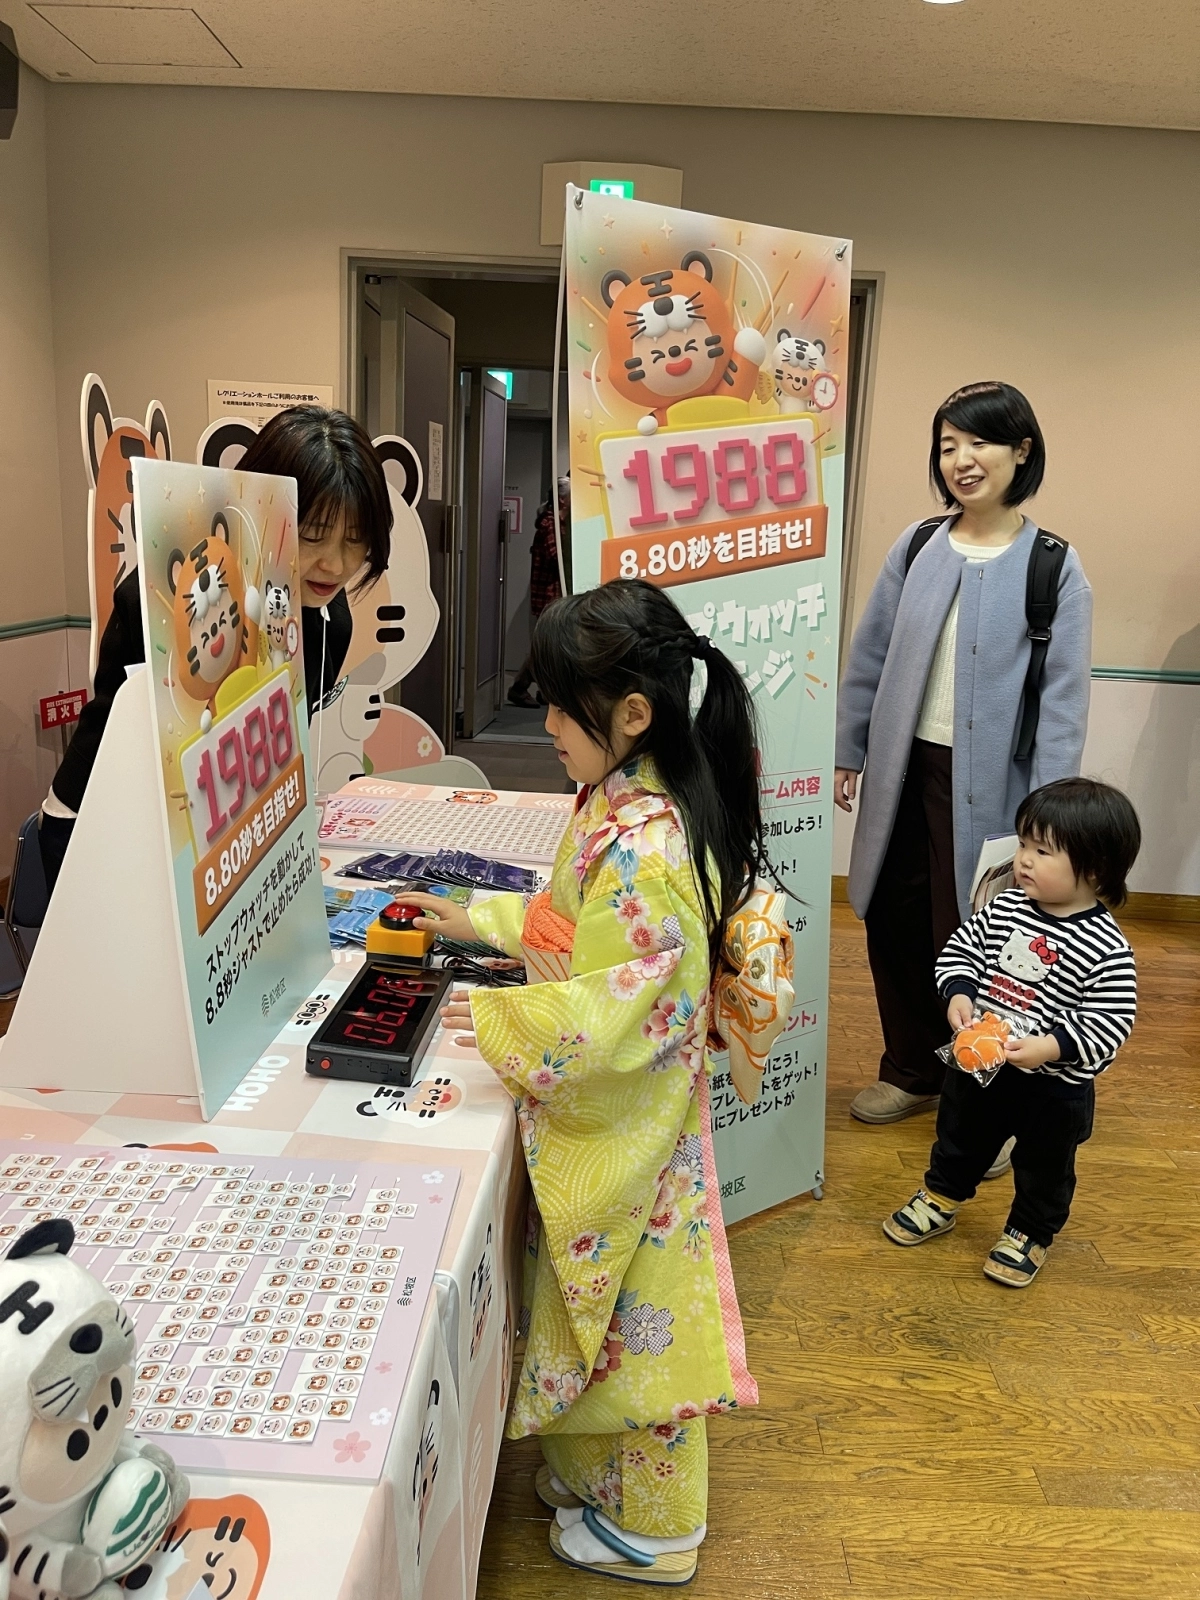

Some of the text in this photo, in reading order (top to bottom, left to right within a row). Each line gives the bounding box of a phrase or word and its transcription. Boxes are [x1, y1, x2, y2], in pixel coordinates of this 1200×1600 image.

[623, 432, 808, 528] 1988
[619, 518, 813, 581] 8.80秒を目指せ!
[197, 686, 294, 842] 1988
[204, 770, 301, 907] 8.80秒を目指せ!
[988, 987, 1032, 1012] KITTY
[991, 974, 1036, 1000] HELLO
[220, 1055, 290, 1112] HOHO
[711, 1090, 796, 1133] にプレゼントが
